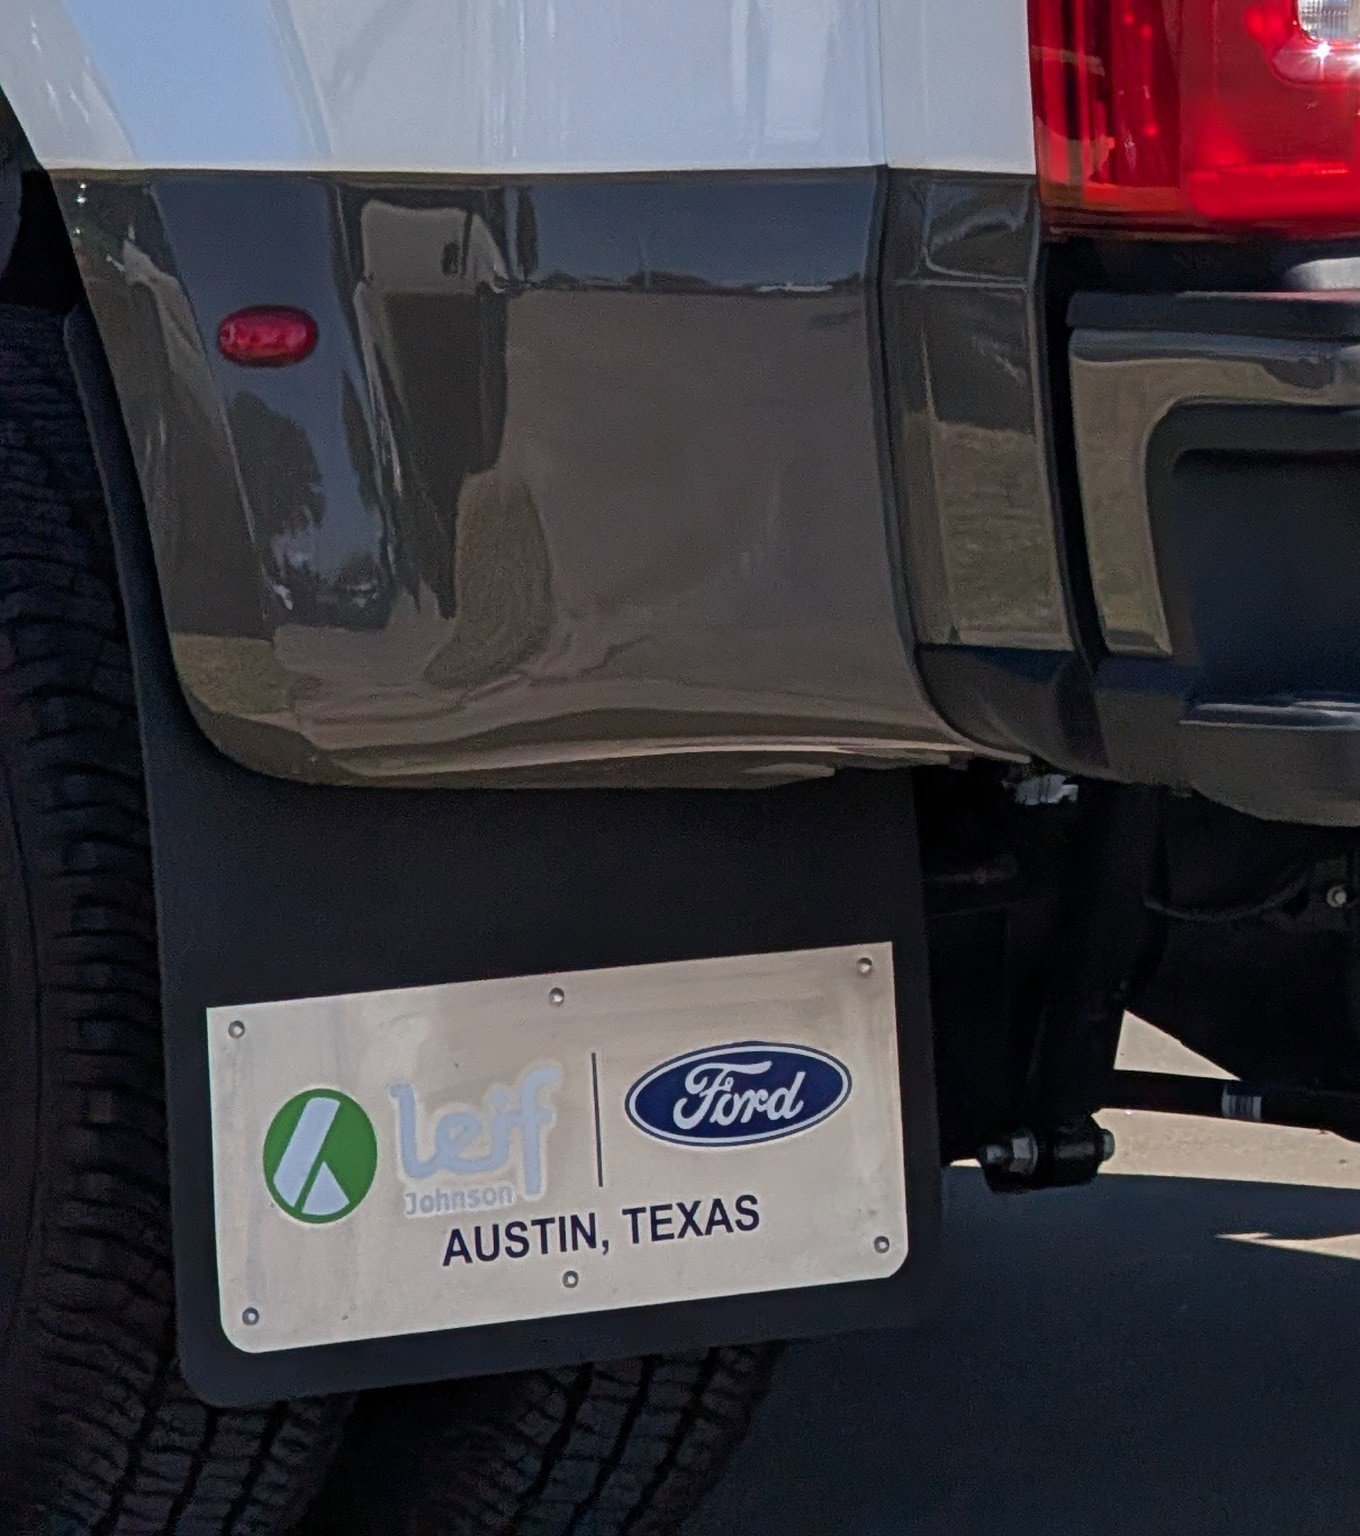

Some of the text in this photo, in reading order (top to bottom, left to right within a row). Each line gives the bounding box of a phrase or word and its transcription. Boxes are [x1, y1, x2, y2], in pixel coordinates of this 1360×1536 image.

[673, 1060, 806, 1130] Ford
[404, 1186, 514, 1216] Johnson
[443, 1194, 760, 1267] AUSTIN, TEXAS
